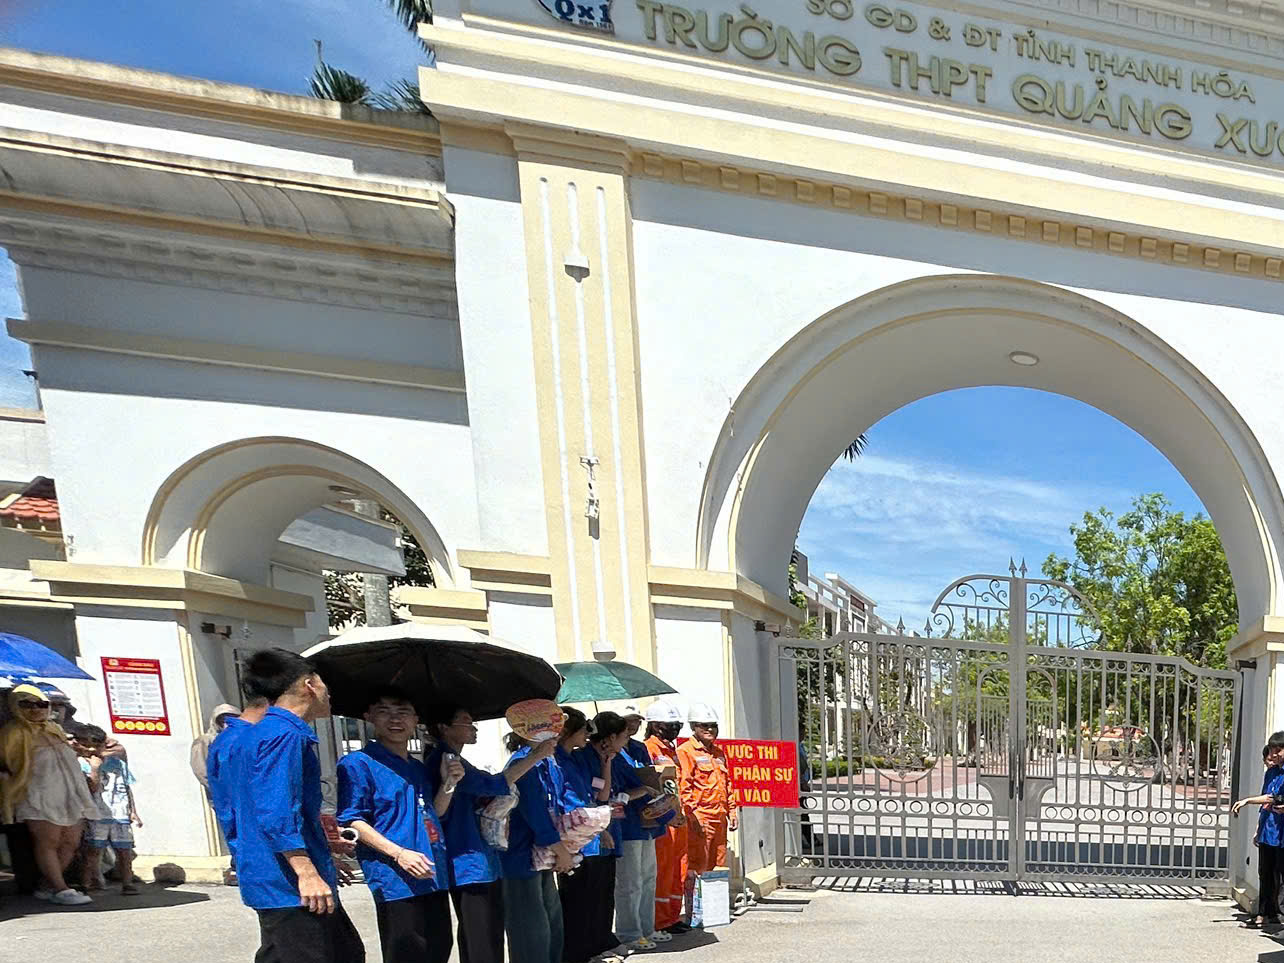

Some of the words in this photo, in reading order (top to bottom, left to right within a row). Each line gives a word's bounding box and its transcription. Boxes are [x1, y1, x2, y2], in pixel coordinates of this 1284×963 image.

[864, 3, 918, 33] GD
[928, 16, 951, 41] &
[963, 23, 1001, 51] ĐT
[1013, 30, 1076, 67] TỈNH
[1085, 48, 1183, 89] THANH
[1192, 71, 1256, 104] HÓA
[636, 0, 862, 76] TRƯỜNG
[884, 46, 993, 103] THPT
[1012, 74, 1193, 140] QUẢNG
[726, 743, 754, 762] VỰC
[757, 745, 778, 760] THI
[733, 765, 771, 783] PHẬN
[774, 767, 794, 784] SỰ
[743, 786, 771, 803] VÀO
